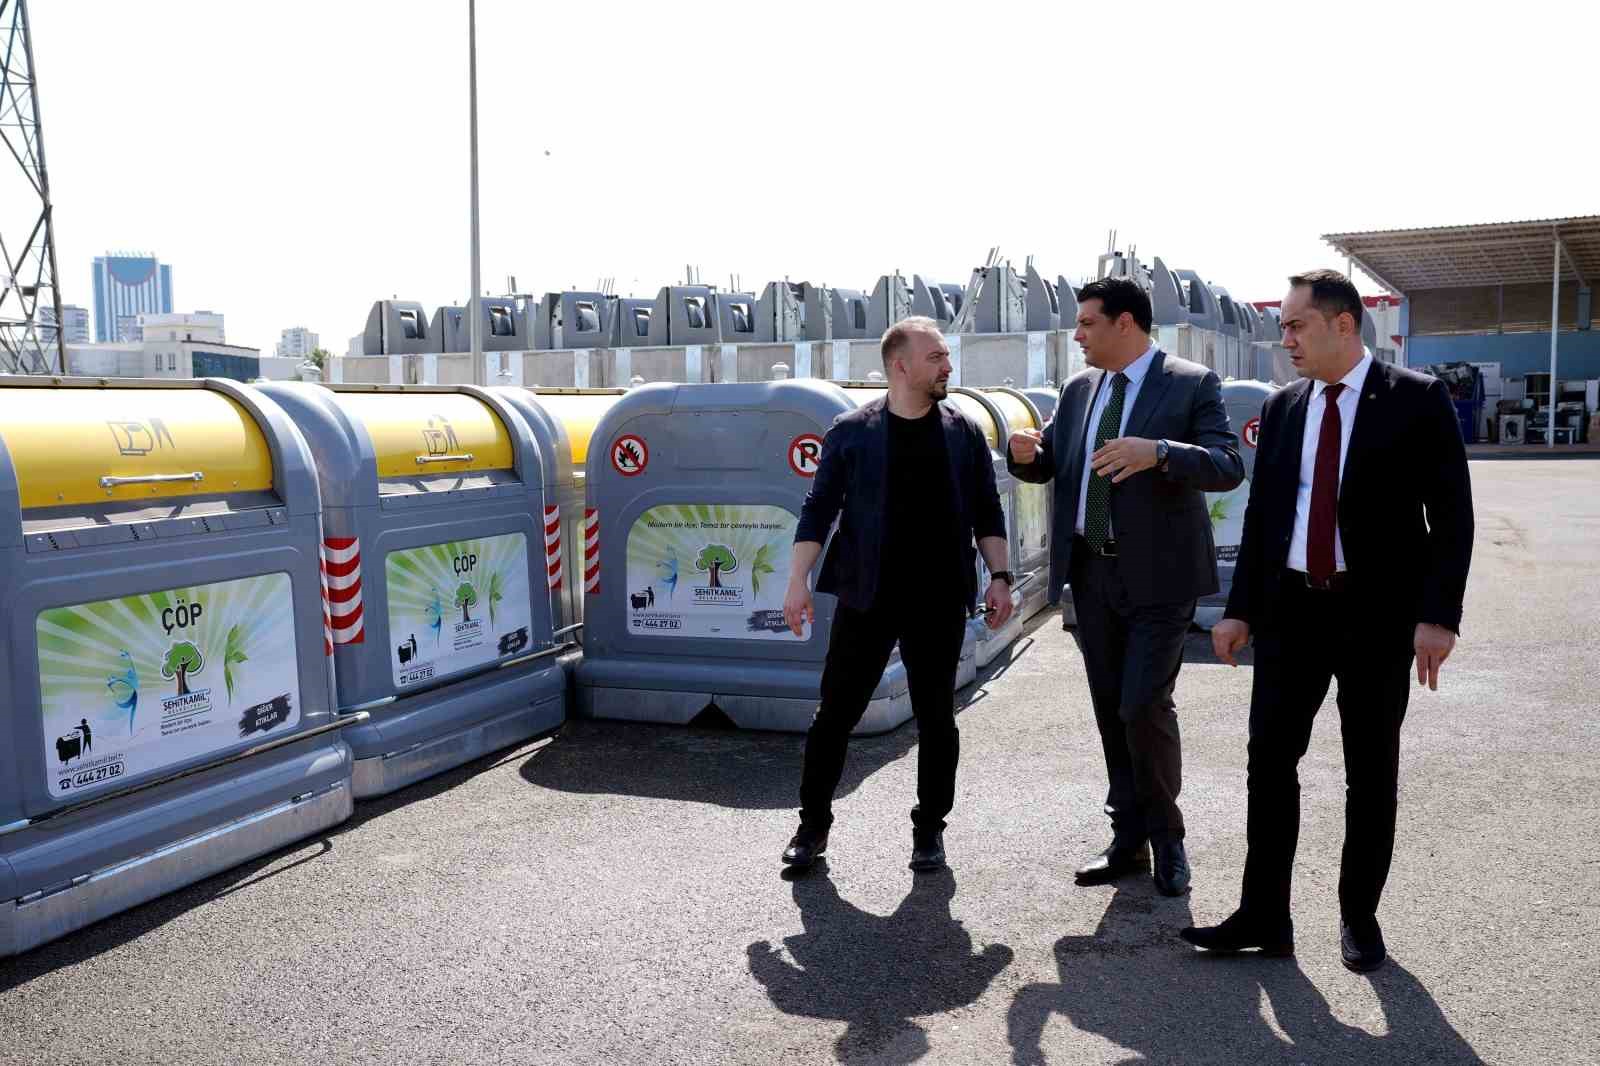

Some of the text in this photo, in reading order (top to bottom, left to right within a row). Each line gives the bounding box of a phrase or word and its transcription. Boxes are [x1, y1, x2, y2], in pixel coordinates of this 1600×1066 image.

[800, 443, 818, 467] P
[453, 552, 477, 577] ÇÖP
[162, 599, 202, 635] ÇÖP
[645, 620, 657, 628] 444
[669, 620, 678, 628] 02
[77, 764, 121, 785] 444 27 02
